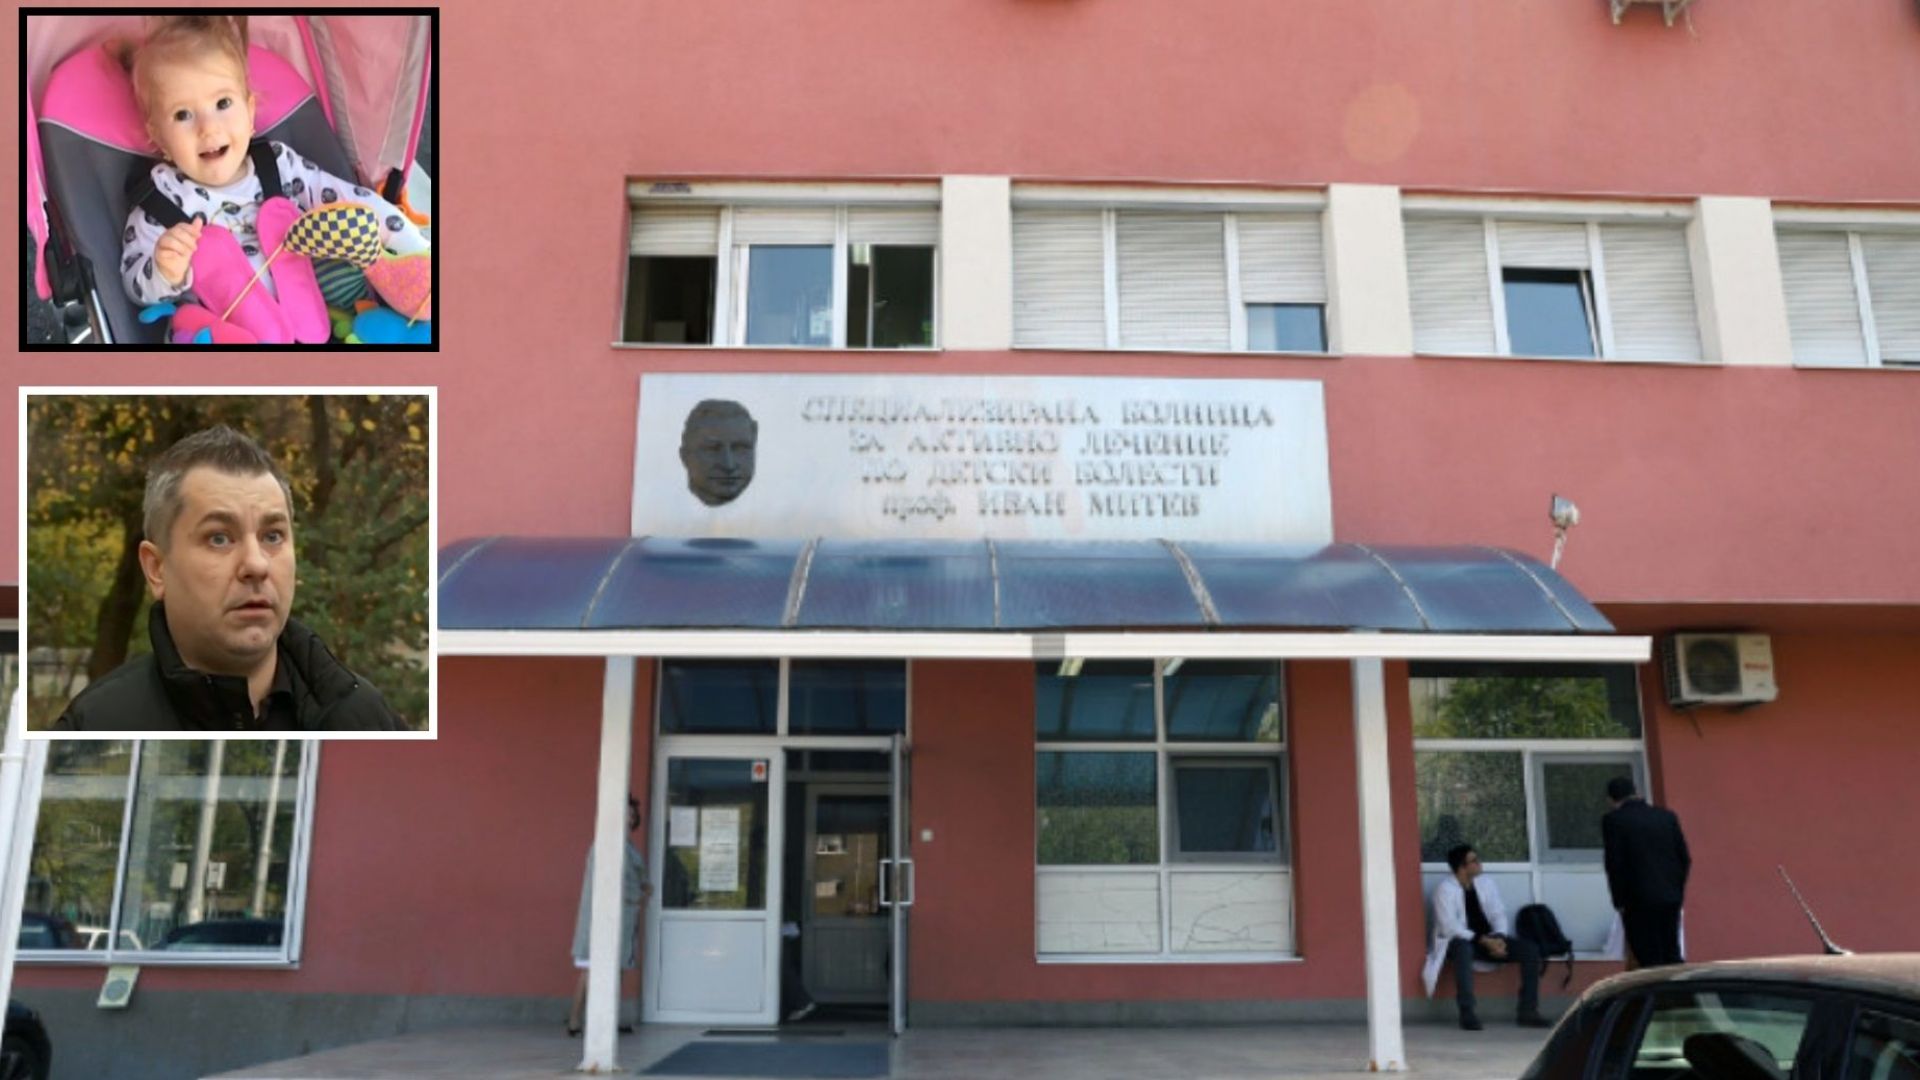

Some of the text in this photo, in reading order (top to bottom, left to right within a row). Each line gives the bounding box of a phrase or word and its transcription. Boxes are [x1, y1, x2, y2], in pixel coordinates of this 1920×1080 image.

[801, 396, 1275, 427] СПЕЦИАЛИЗИРАНА БОЛНИЦА
[849, 428, 1231, 456] ЗА АКТИВНО ЛЕЧЕНИЕ
[861, 456, 1221, 487] ПО ДЕТСКИ БОЛЕСТИ
[977, 489, 1067, 517] ИВАН
[1089, 491, 1201, 518] МИТЕВ
